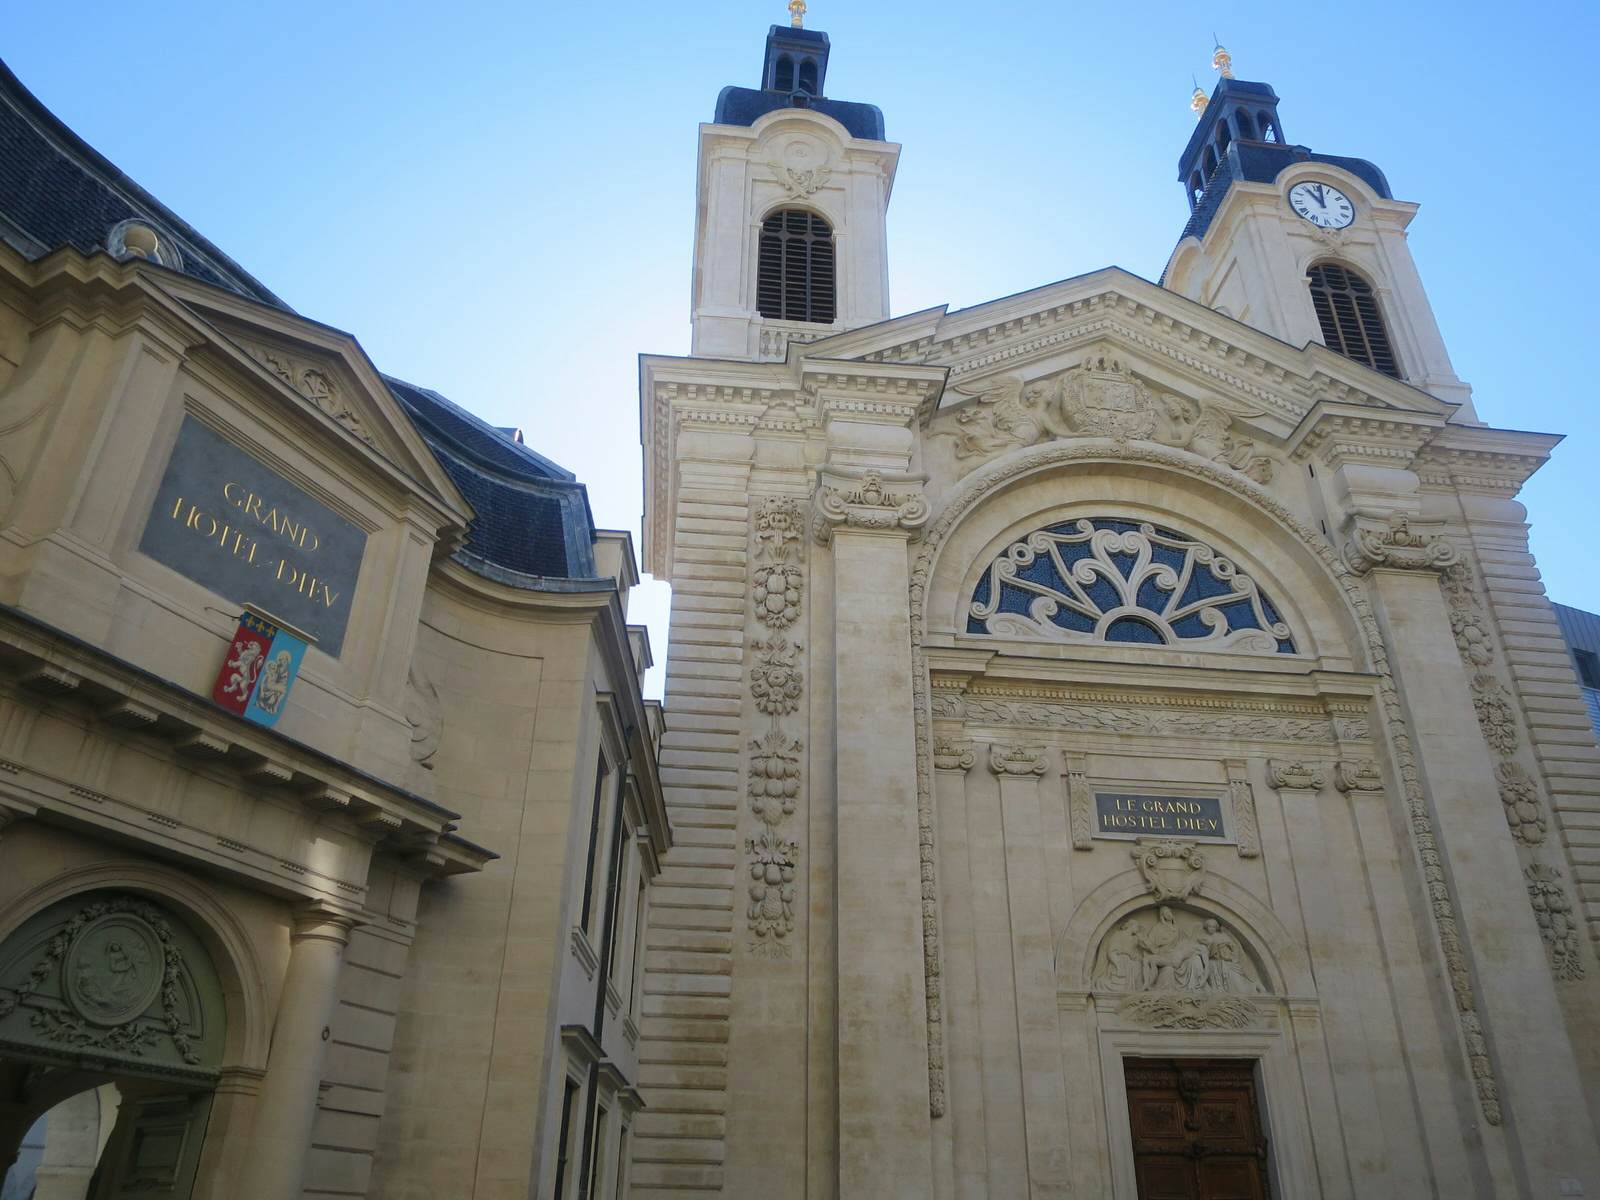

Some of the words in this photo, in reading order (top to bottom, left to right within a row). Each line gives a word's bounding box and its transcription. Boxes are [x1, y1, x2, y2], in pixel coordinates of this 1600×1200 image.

[224, 482, 319, 551] GRAND
[1116, 799, 1138, 812] LE
[1142, 800, 1201, 814] GRAND
[1103, 814, 1172, 829] HOSTEL
[1177, 817, 1218, 831] DIEV
